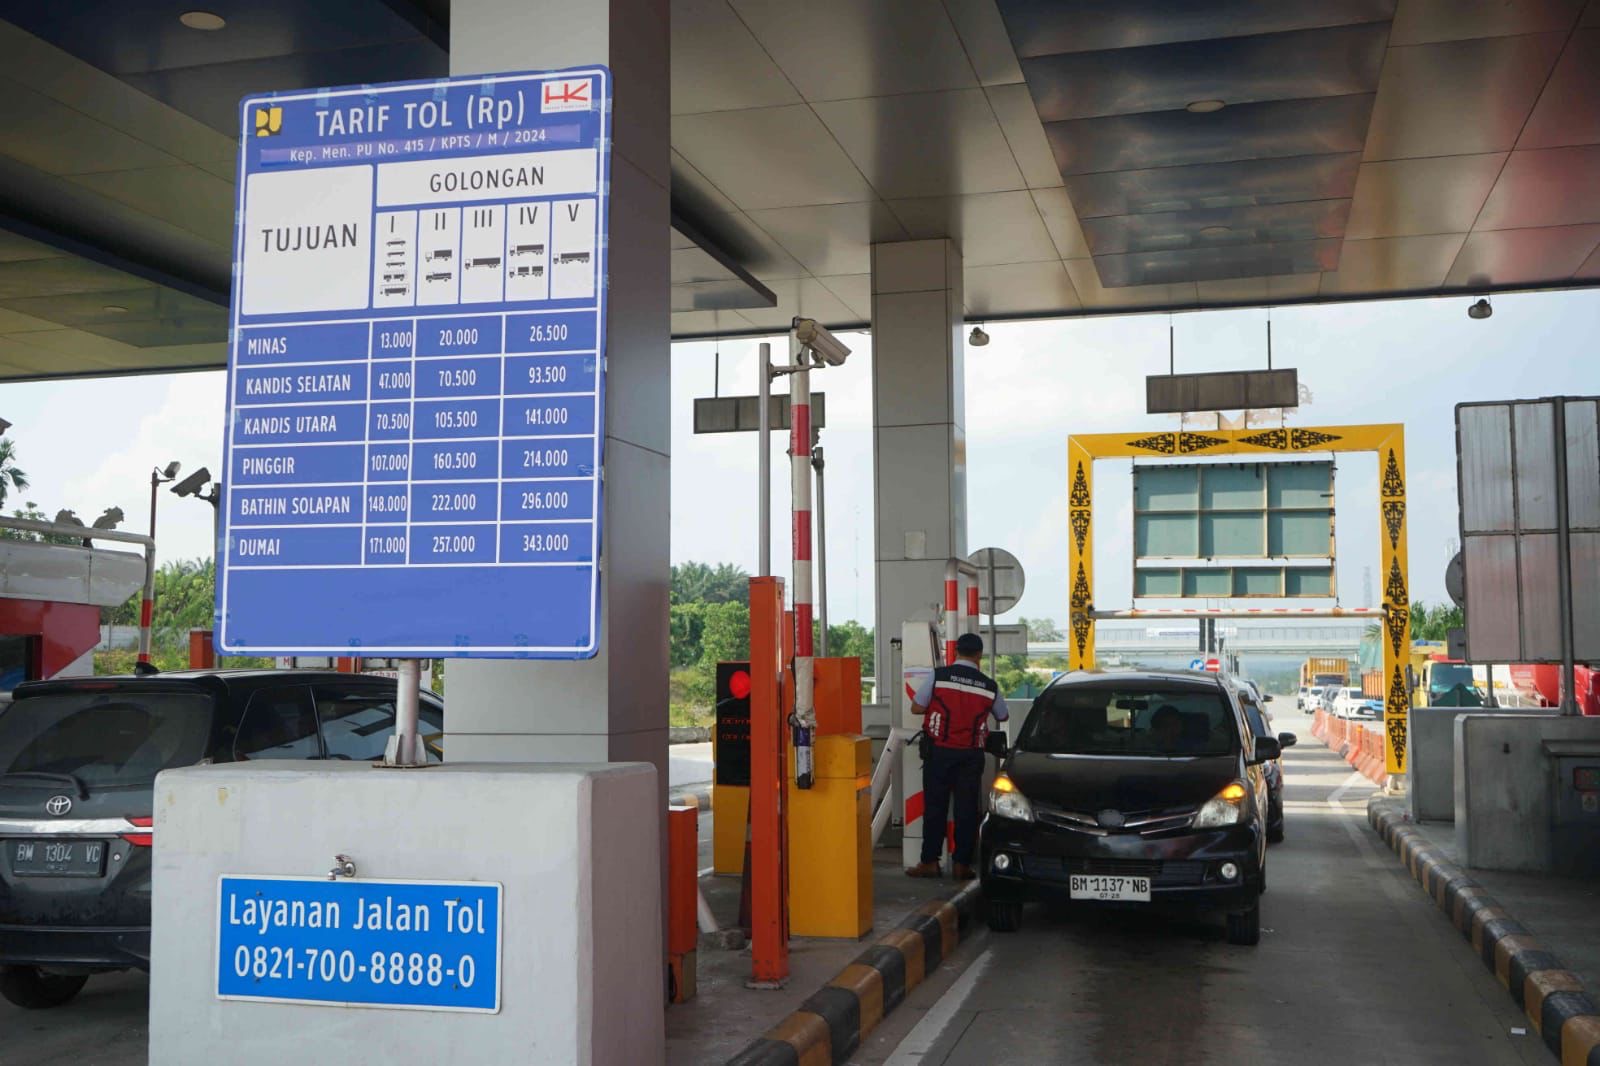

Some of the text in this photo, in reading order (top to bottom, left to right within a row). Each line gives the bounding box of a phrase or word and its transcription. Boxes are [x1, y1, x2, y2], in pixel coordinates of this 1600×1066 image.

[316, 90, 525, 137] TARIF TOL (Rp)
[290, 129, 546, 164] Kep. Men. PU No. 415 / KPTS / M / 2024
[430, 166, 544, 193] GOLONGAN
[390, 203, 579, 232] I II III IV V
[262, 223, 358, 252] TUJUAN
[248, 325, 567, 355] MINAS 13.000 20.000 26.500
[246, 366, 566, 394] KANDIS SELATAN 47.000 70.500 93.500
[244, 408, 567, 435] KANDIS UTARA 70.500 105.500 141.000
[243, 450, 567, 475] PINGGIR 107.000 160.500 214.000
[241, 491, 568, 515] BATHIN SOLAPAN 148.000 222.000 296.000
[239, 534, 568, 556] DUMAI 171.000 257.000 343.000
[17, 844, 100, 862] BM 1304 VC
[1072, 878, 1148, 892] BM 1137 NB
[230, 893, 484, 935] Layanan Jalan Tol
[234, 945, 476, 988] 0821-700-8888-0
